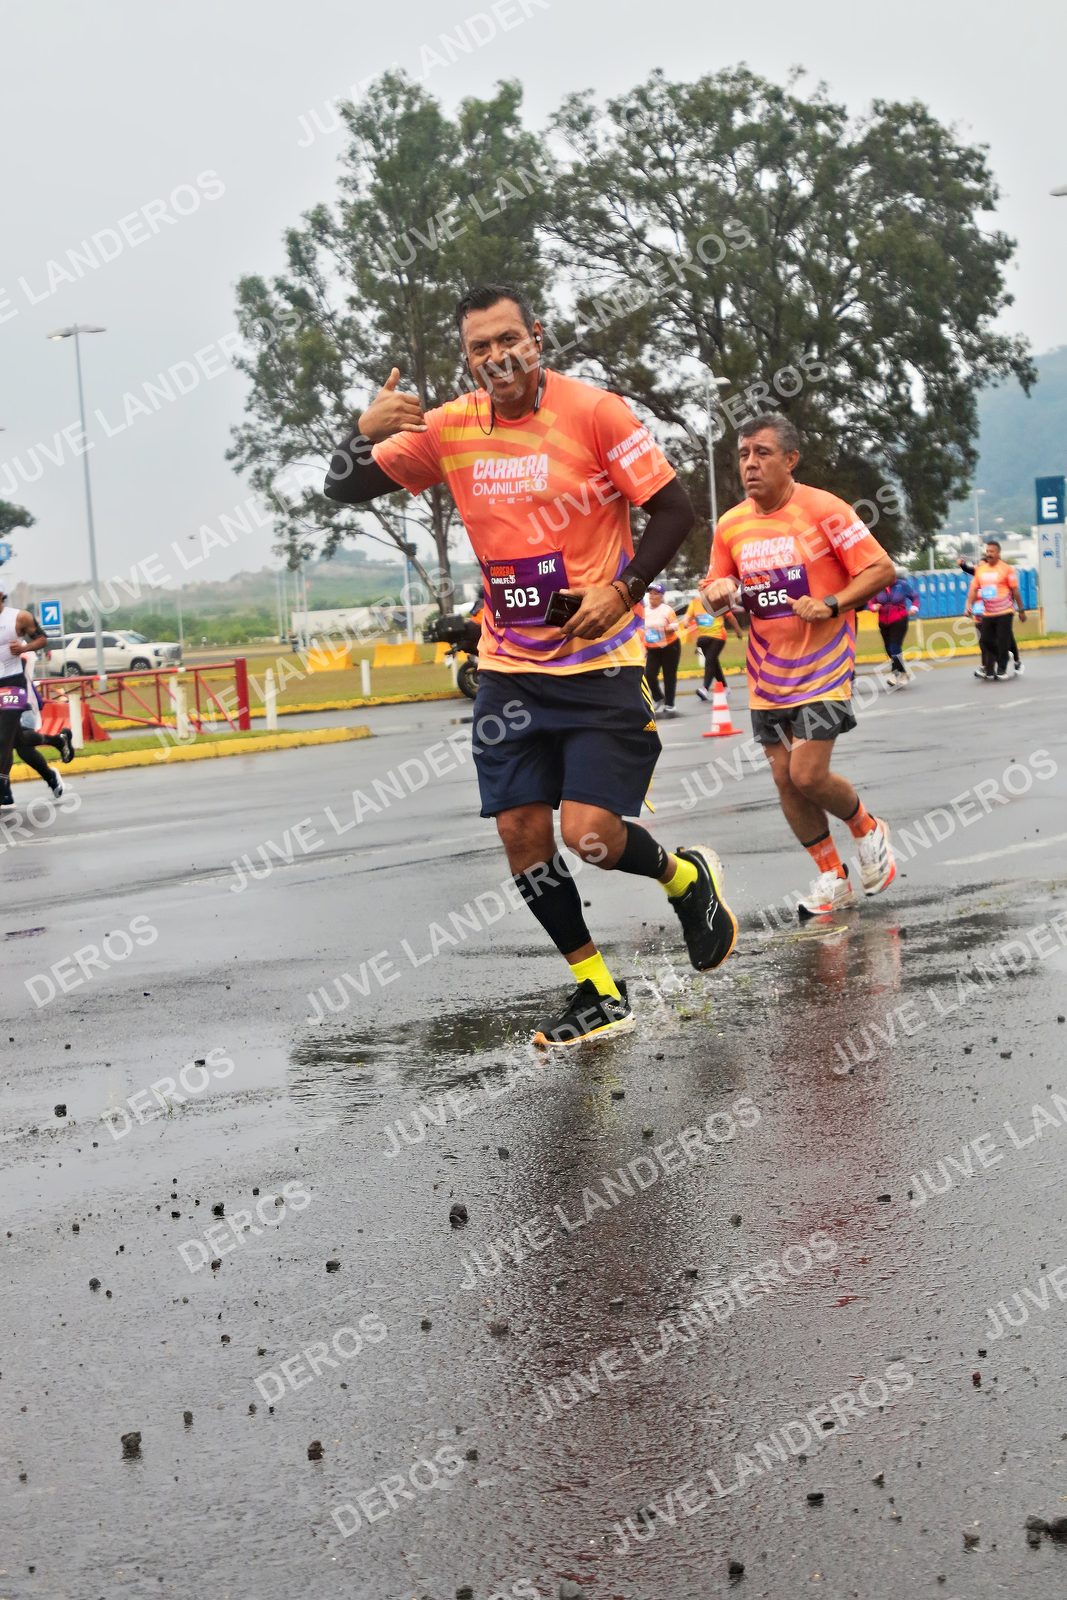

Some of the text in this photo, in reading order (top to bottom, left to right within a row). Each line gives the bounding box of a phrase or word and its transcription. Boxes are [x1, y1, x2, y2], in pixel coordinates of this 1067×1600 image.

[472, 453, 549, 480] CARRERA
[472, 480, 531, 496] OMNILIFE
[1041, 496, 1059, 519] E
[537, 558, 557, 575] 15K
[504, 587, 541, 608] 503
[758, 589, 788, 607] 656
[3, 695, 19, 703] 572
